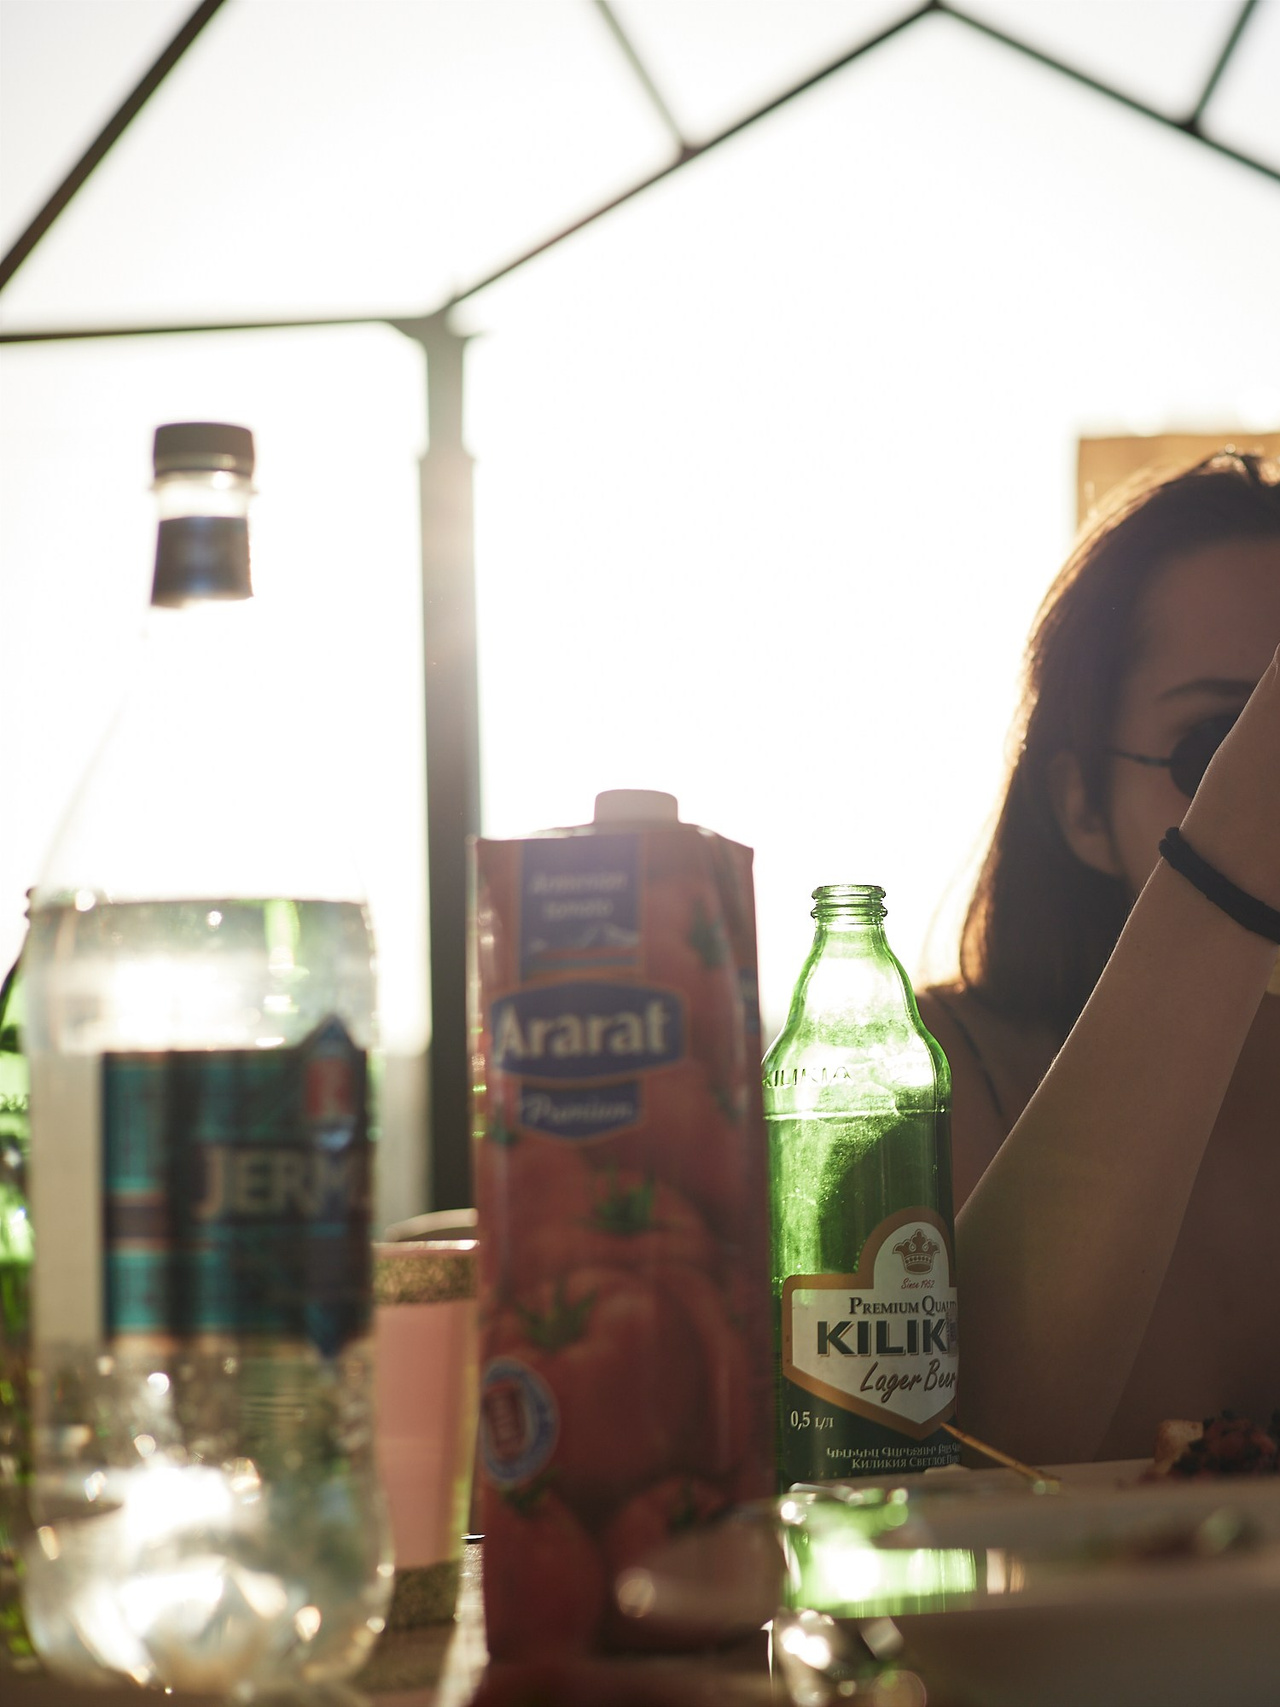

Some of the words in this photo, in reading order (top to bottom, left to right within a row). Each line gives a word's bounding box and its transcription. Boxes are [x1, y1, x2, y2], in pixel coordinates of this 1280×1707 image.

[497, 1000, 671, 1060] Ararat
[849, 1296, 919, 1315] PREMIUM
[816, 1319, 948, 1357] KILIK
[860, 1361, 922, 1403] Lager
[923, 1358, 956, 1391] Beer
[790, 1410, 811, 1430] 0,5
